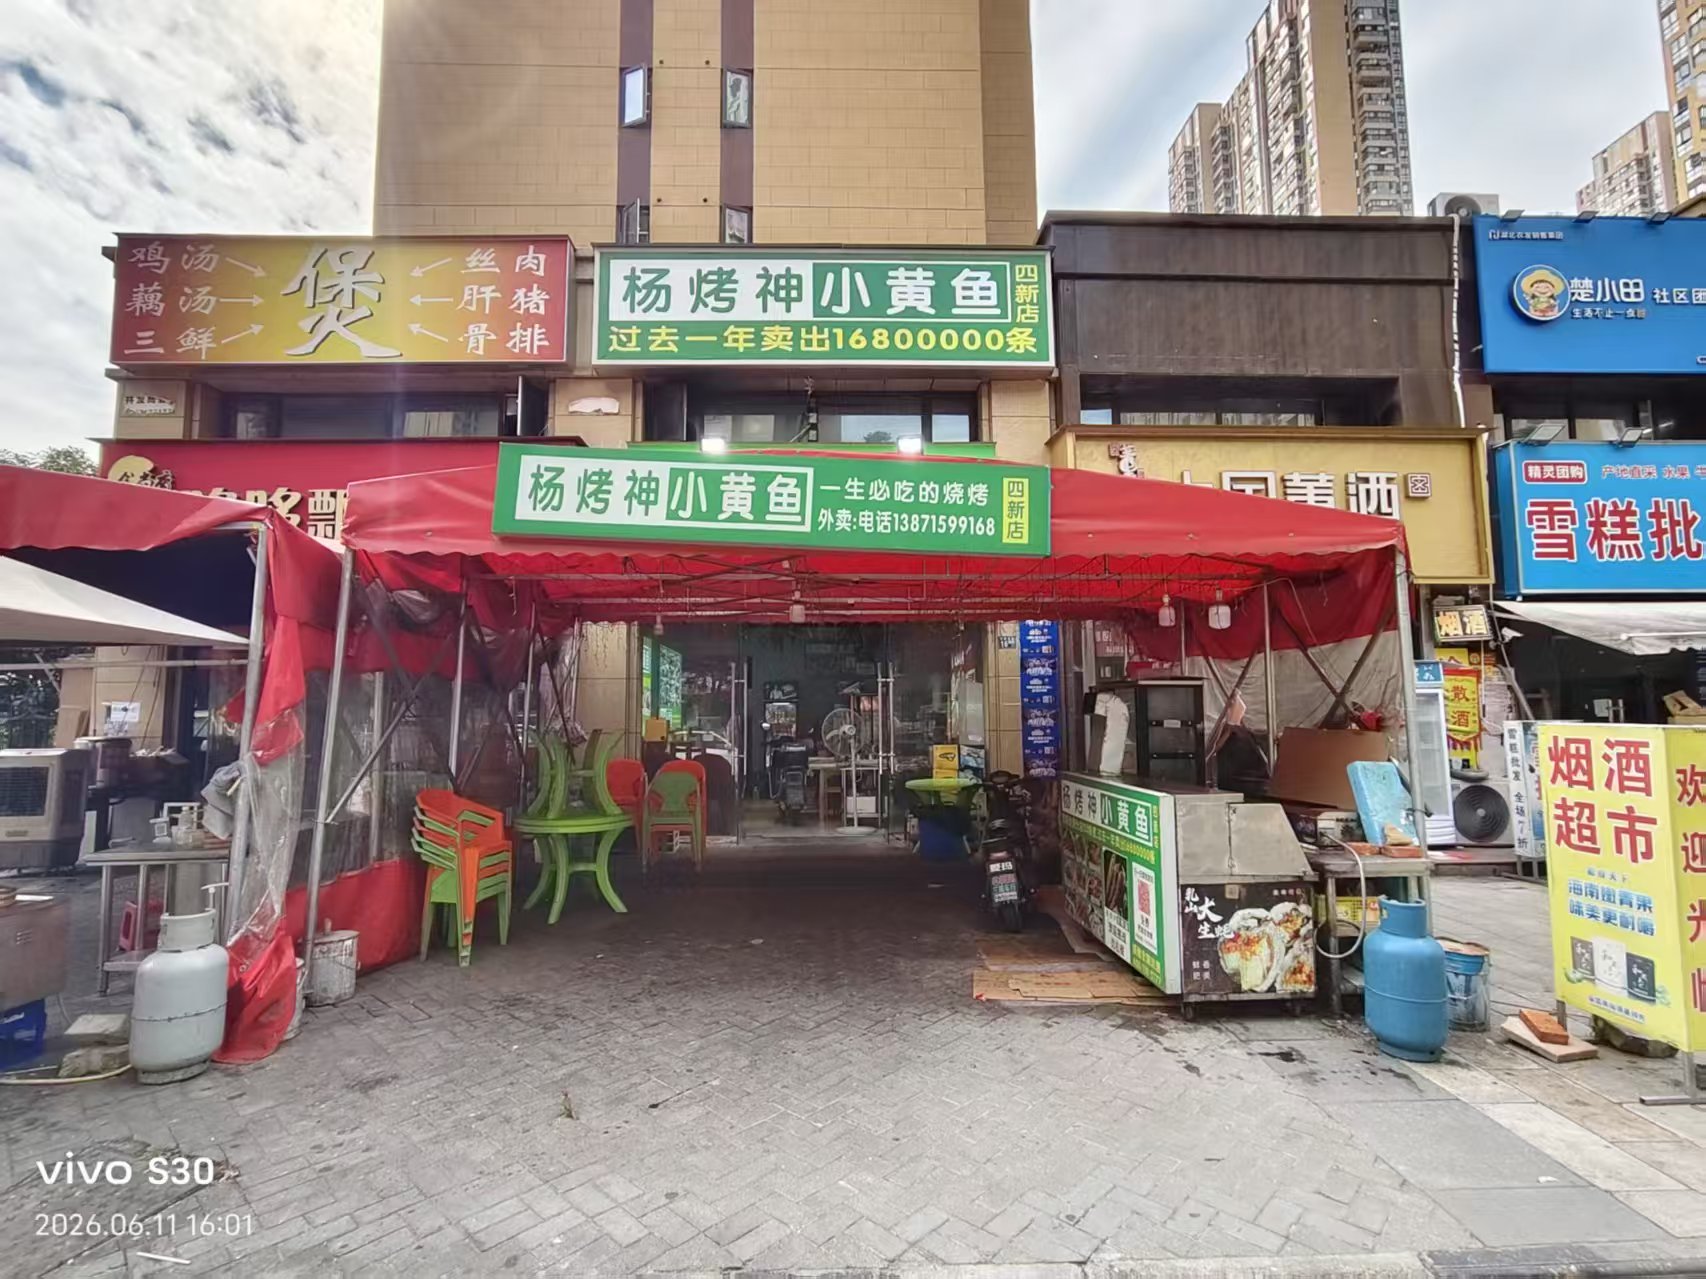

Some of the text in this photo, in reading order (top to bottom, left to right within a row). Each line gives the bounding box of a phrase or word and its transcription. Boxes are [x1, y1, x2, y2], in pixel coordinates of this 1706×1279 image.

[128, 240, 221, 275] 鸡汤
[125, 283, 217, 317] 藕汤
[281, 245, 403, 359] 煲
[621, 265, 1002, 316] 杨烤神小黄鱼
[1014, 264, 1040, 323] 四新店
[1570, 276, 1646, 303] 楚小田
[124, 326, 219, 360] 三鲜
[608, 325, 1038, 354] 过去一年卖出16800000条
[528, 462, 803, 524] 杨烤神小黄鱼
[819, 477, 990, 508] 一生必吃的烧烤
[1527, 464, 1584, 480] 精灵团购
[1006, 481, 1027, 541] 四新店
[1526, 498, 1703, 562] 雪糕批
[1438, 610, 1488, 637] 烟酒
[1450, 684, 1471, 728] 散酒
[1548, 735, 1654, 798] 烟酒
[1553, 796, 1658, 864] 超市
